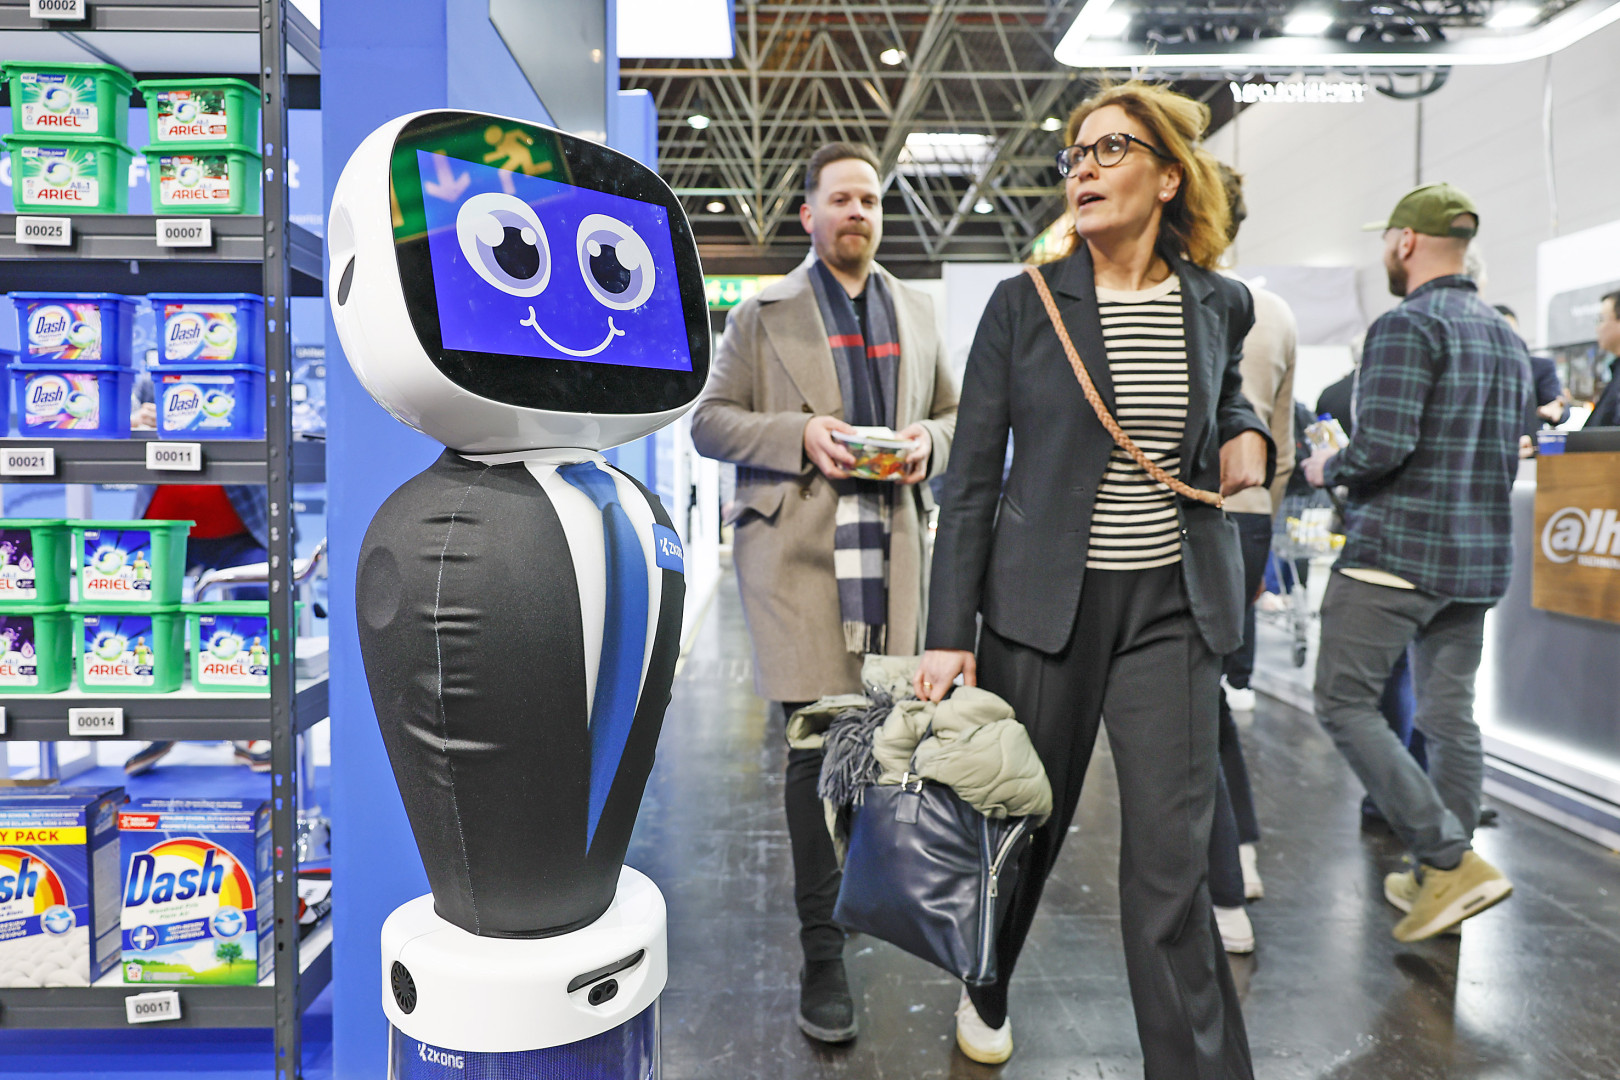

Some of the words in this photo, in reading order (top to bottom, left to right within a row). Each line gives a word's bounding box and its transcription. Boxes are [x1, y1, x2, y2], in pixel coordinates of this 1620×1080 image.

[38, 0, 76, 11] 00002
[36, 115, 81, 127] ARIEL
[169, 125, 206, 135] ARIEL
[37, 189, 82, 200] ARIEL
[171, 189, 207, 199] ARIEL
[25, 225, 63, 237] 00025
[165, 227, 202, 239] 00007
[36, 316, 67, 334] Dash
[171, 322, 201, 341] Dash
[32, 385, 63, 404] Dash
[169, 393, 199, 412] Dash
[9, 456, 45, 467] 00021
[155, 451, 192, 462] 00011
[88, 579, 130, 590] ARIEL
[88, 665, 132, 676] ARIEL
[203, 664, 247, 675] ARIEL
[78, 717, 114, 727] 00014
[15, 830, 59, 842] PACK
[125, 849, 224, 908] Dash
[135, 1001, 171, 1014] 00017
[427, 1048, 465, 1069] ZKONG
